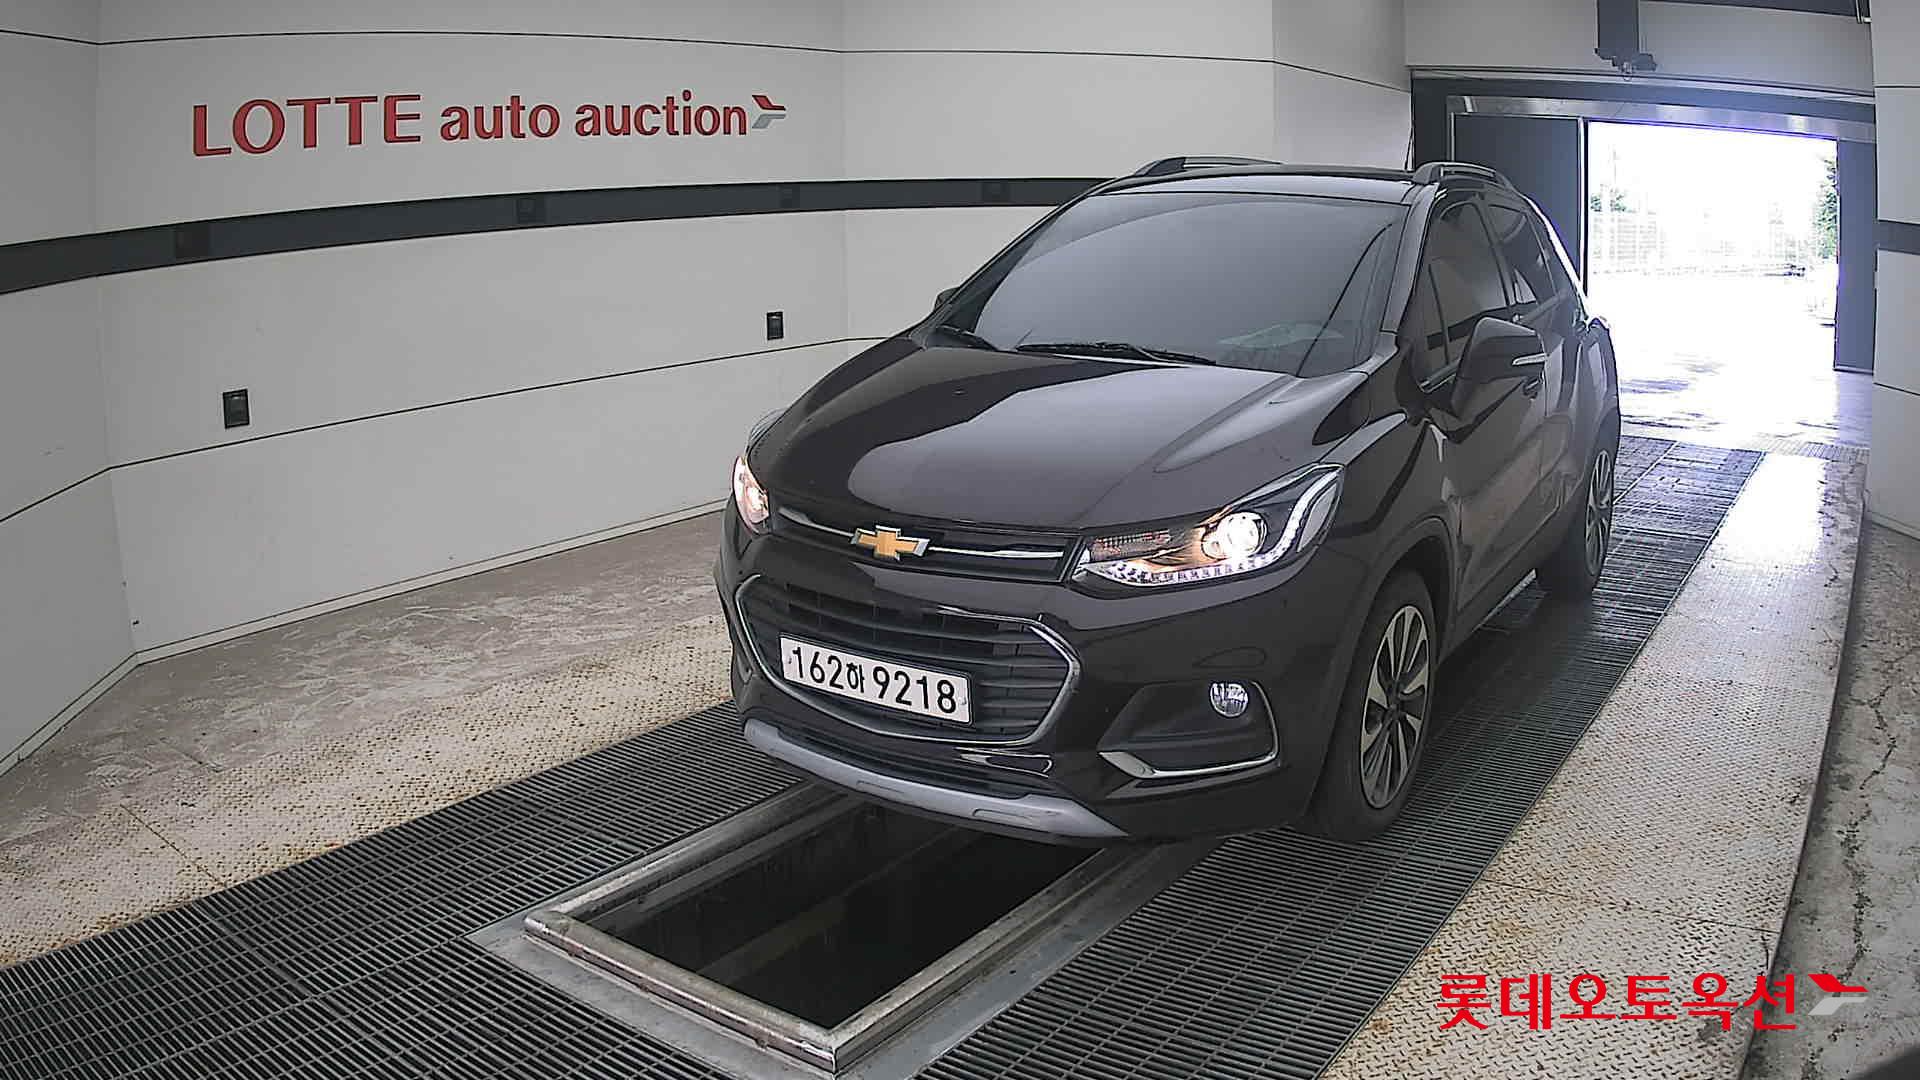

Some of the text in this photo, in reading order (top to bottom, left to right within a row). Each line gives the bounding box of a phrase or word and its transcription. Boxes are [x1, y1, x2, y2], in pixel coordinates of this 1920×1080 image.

[193, 90, 748, 157] LOTTE auto auction
[872, 666, 956, 714] 9218
